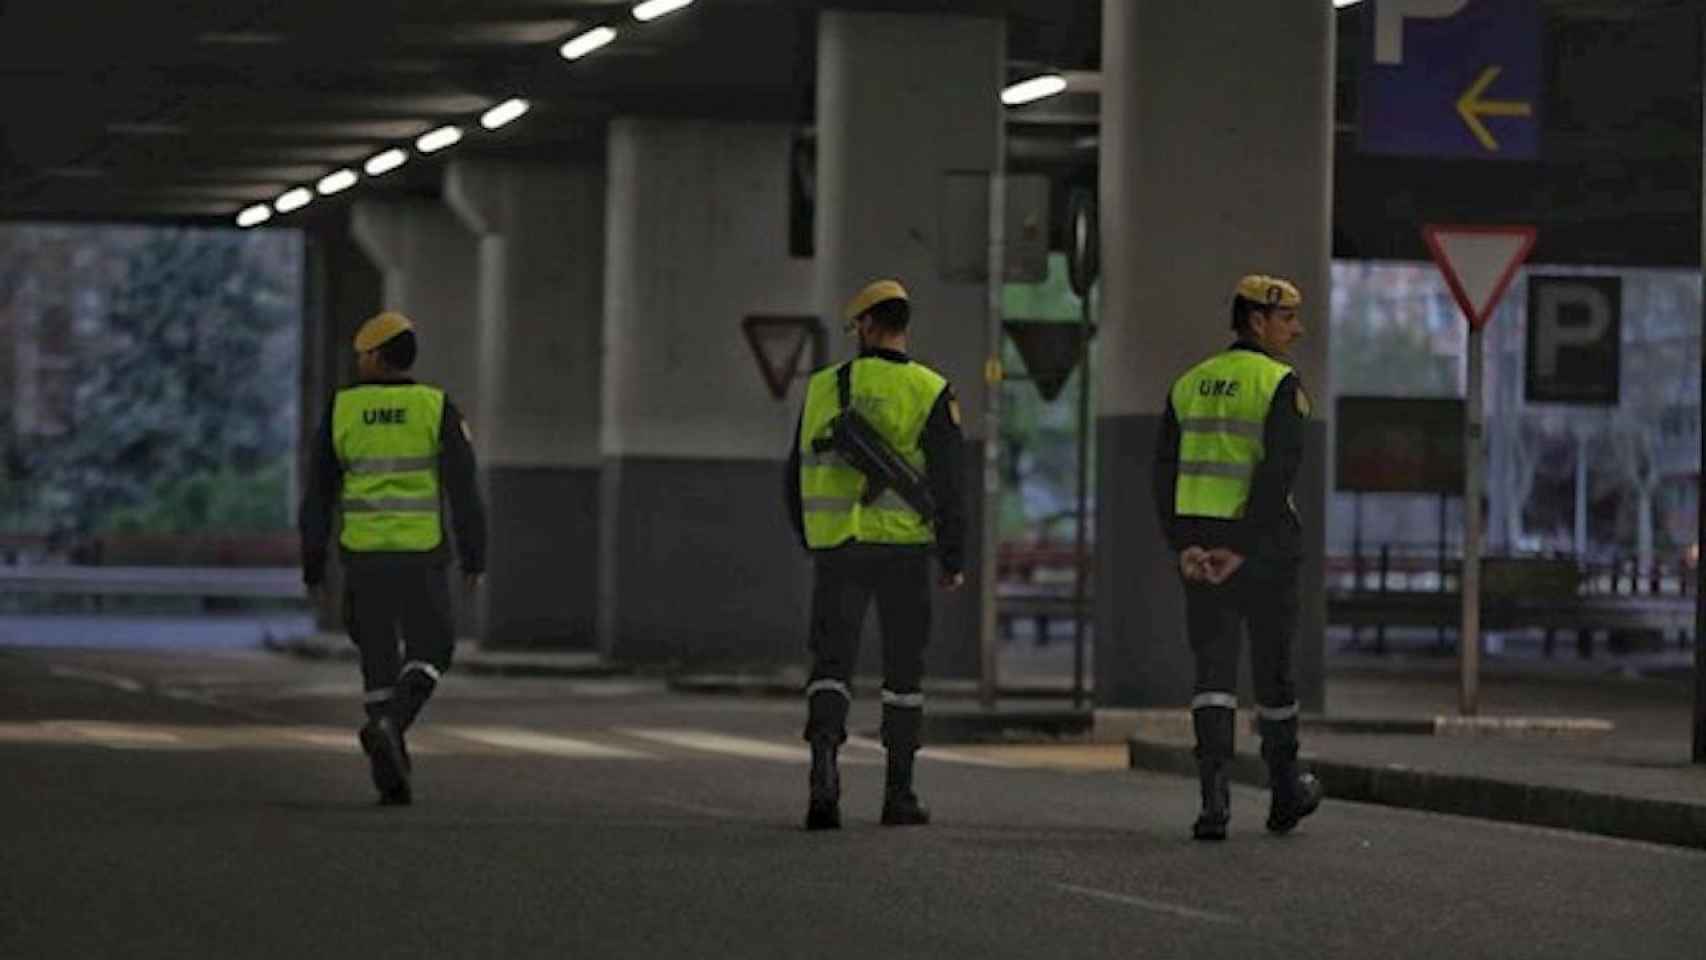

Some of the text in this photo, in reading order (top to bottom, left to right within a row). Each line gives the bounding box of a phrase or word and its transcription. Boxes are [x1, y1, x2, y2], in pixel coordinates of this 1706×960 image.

[1536, 283, 1611, 375] P
[1200, 379, 1241, 397] UME
[362, 408, 407, 425] UME
